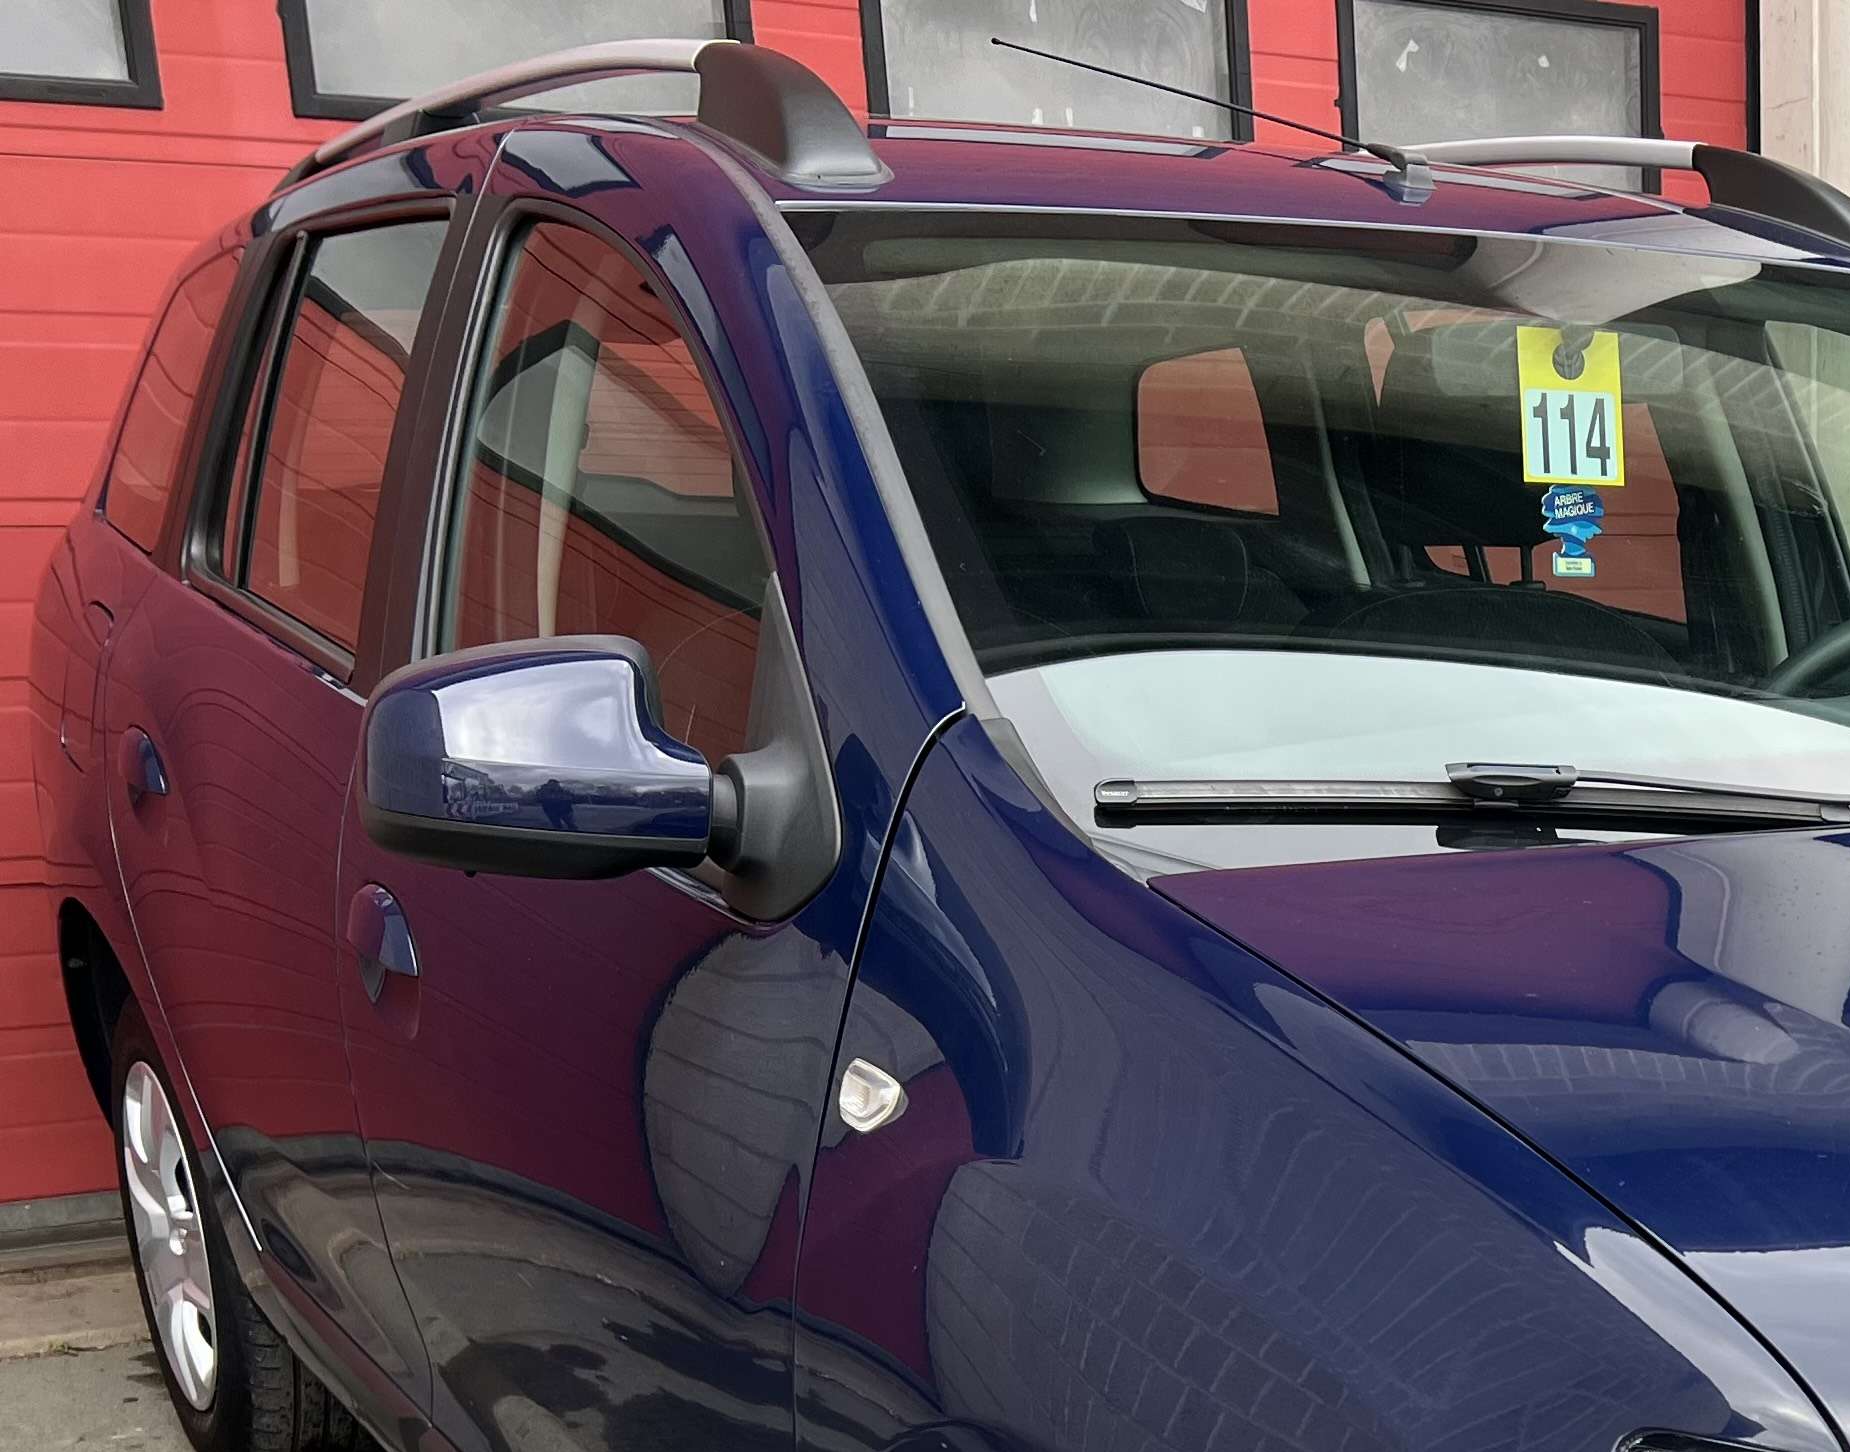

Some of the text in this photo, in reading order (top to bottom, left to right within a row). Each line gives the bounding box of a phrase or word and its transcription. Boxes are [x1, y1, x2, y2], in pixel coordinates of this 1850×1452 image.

[1533, 392, 1610, 477] 114
[1554, 492, 1583, 507] ARBRE
[1554, 502, 1594, 519] MAGIQUE
